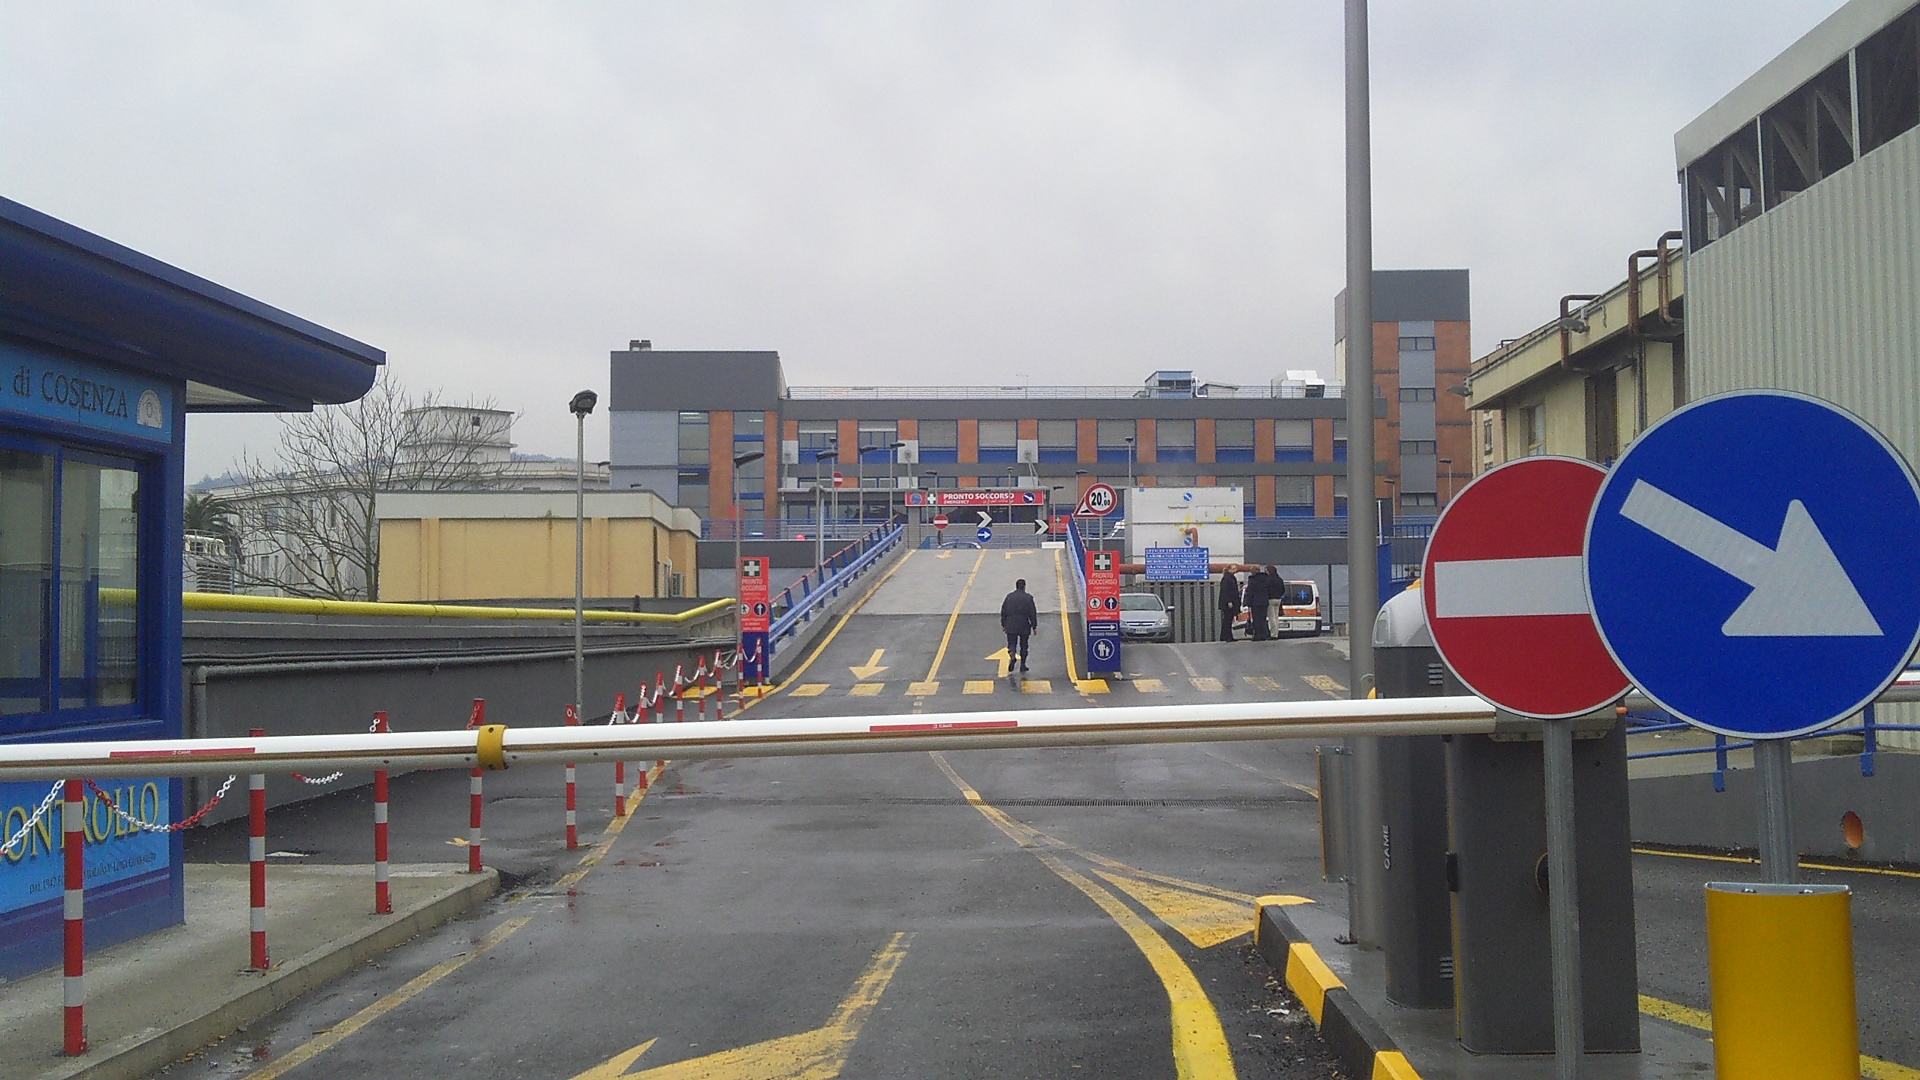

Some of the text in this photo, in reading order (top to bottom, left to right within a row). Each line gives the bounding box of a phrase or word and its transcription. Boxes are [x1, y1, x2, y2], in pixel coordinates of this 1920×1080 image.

[14, 366, 129, 418] di COSENZA
[975, 492, 1015, 500] SOCCORSO
[1088, 578, 1118, 586] SOCCORSO
